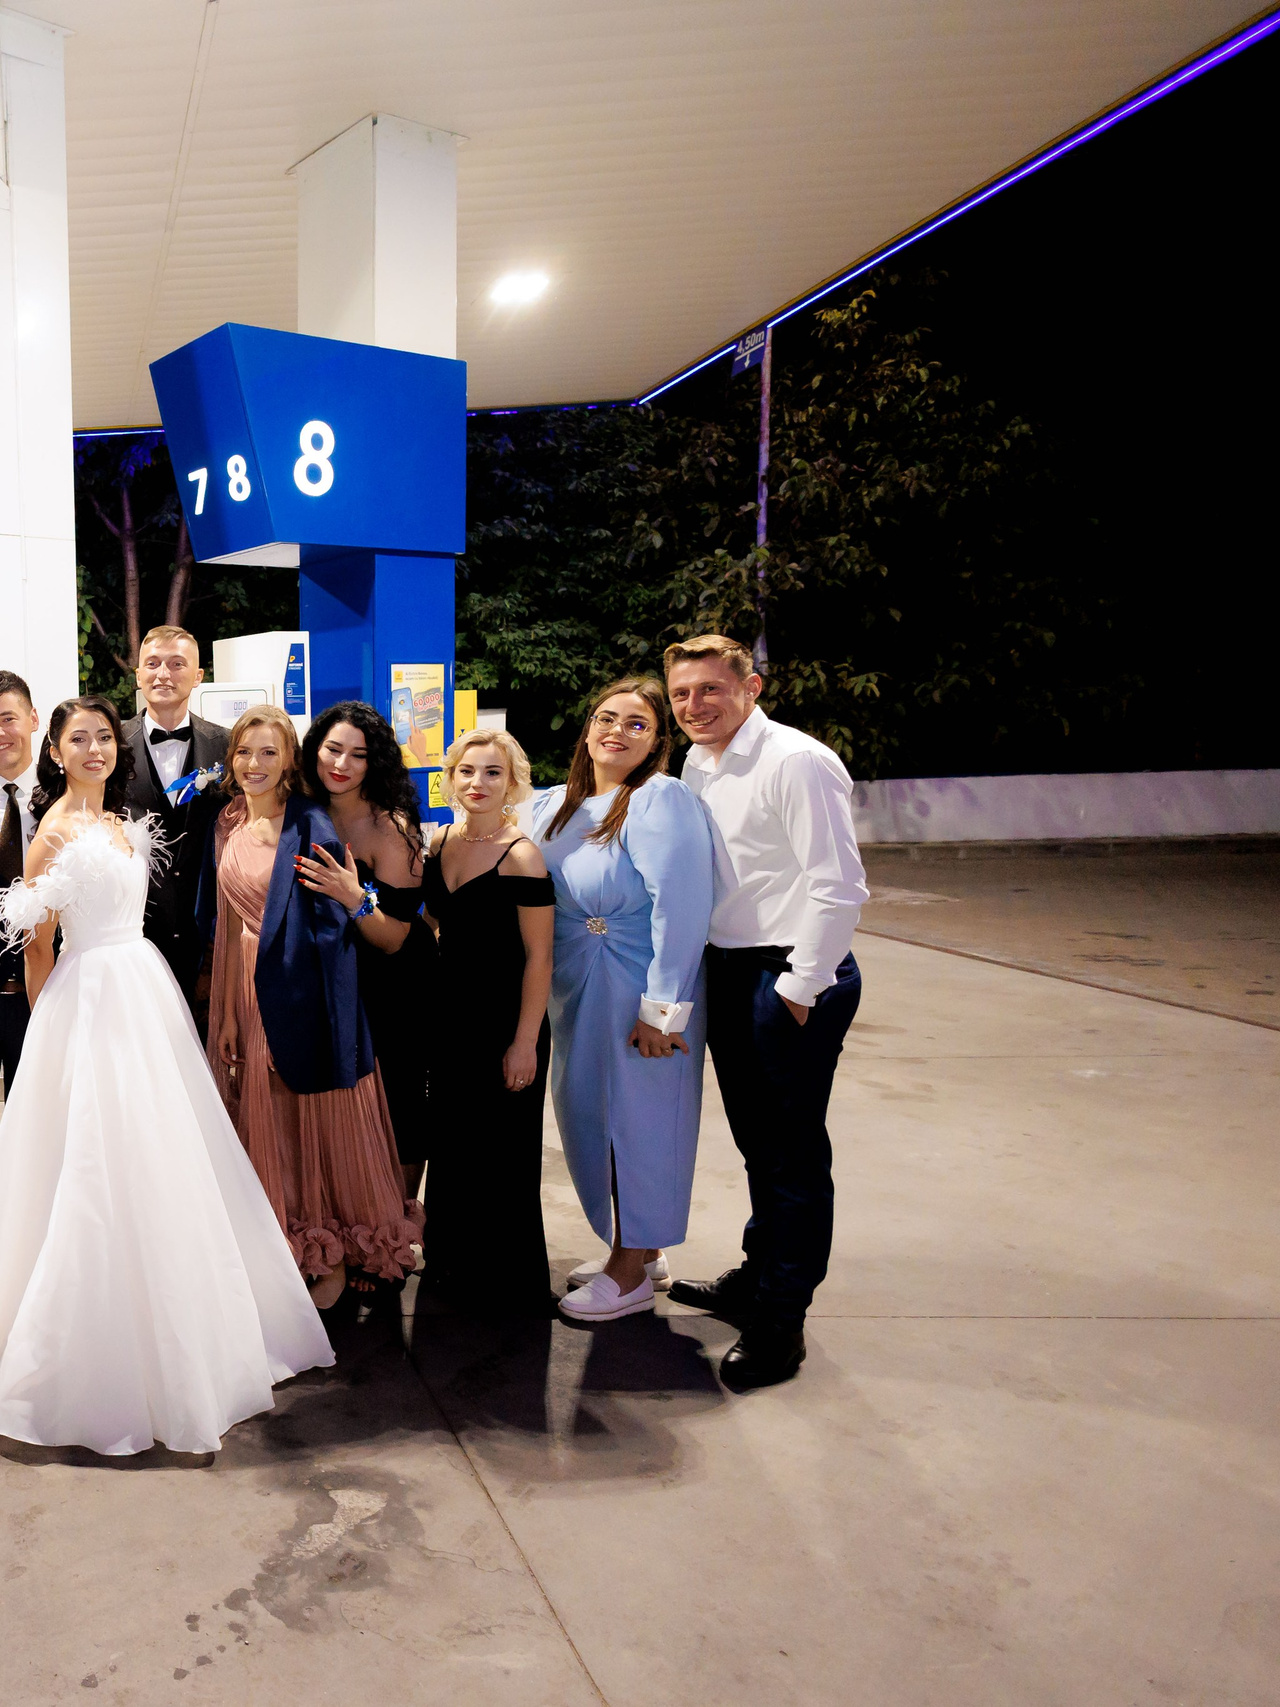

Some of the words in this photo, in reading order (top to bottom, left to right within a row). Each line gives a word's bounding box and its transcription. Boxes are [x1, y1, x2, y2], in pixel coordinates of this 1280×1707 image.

[737, 331, 765, 354] 4,50m
[293, 420, 336, 497] 8
[187, 467, 208, 516] 7
[226, 454, 251, 502] 8
[413, 698, 424, 708] 60
[425, 693, 440, 704] 000
